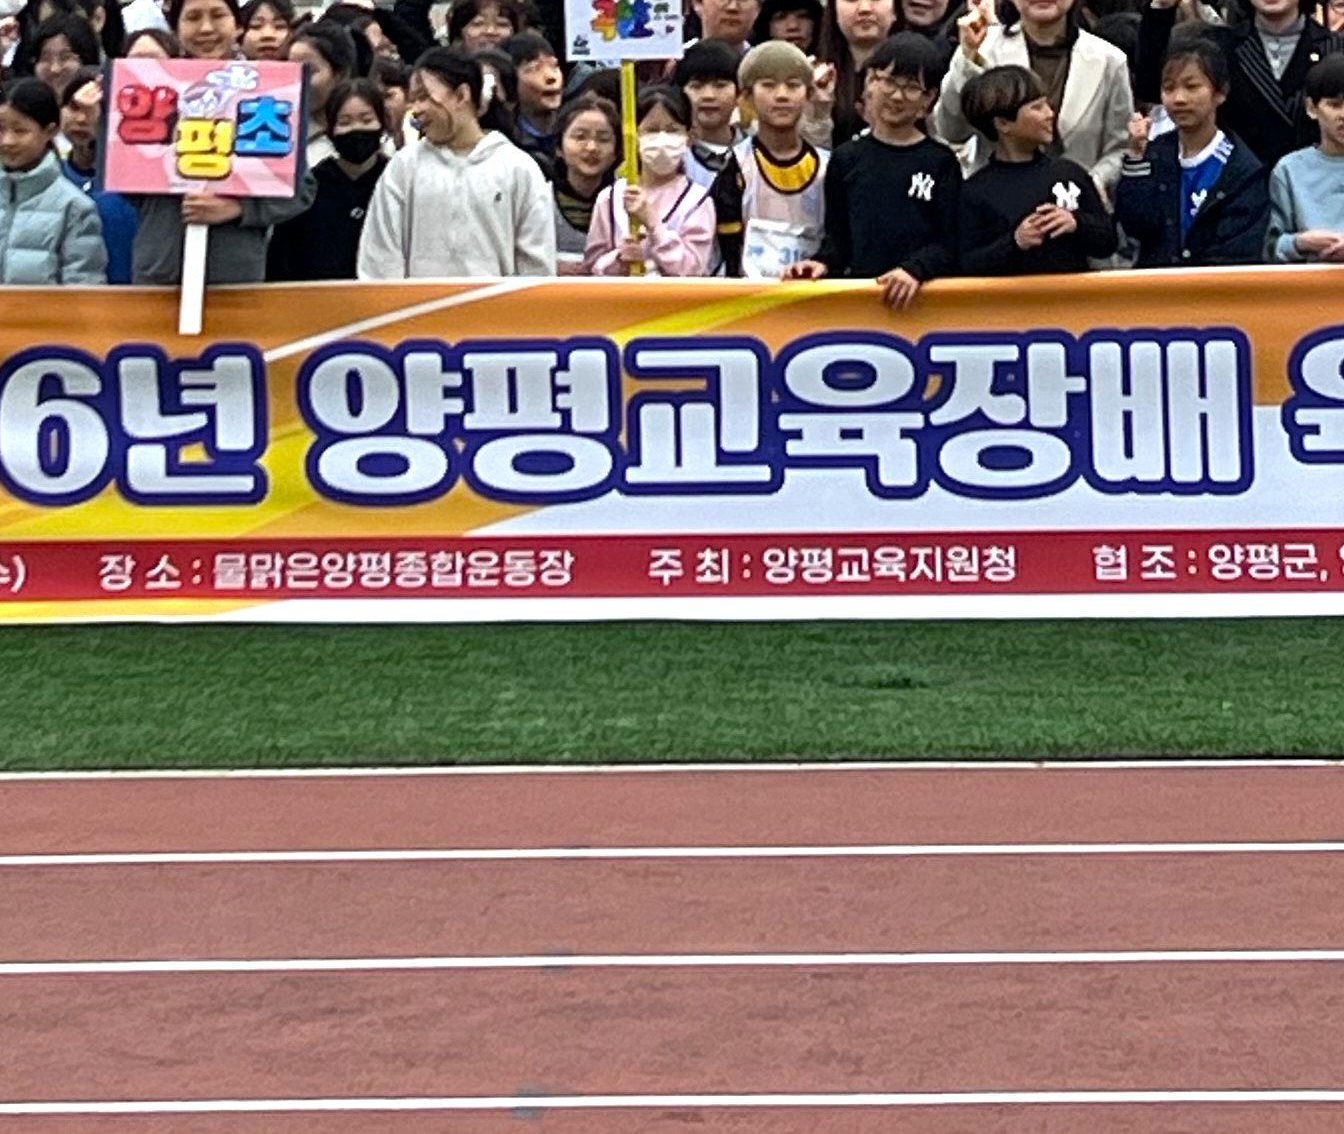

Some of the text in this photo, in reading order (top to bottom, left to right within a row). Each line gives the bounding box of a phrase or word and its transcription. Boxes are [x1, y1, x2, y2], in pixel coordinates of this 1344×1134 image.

[117, 84, 293, 180] 양평초
[293, 329, 1257, 506] 양평교육장배
[99, 554, 135, 591] 장
[213, 550, 574, 590] 물맑은양평종합운동장
[648, 548, 684, 585] 주
[762, 544, 1017, 584] 양평교육지원청
[1092, 544, 1128, 584] 협
[1207, 542, 1329, 582] 양평군,
